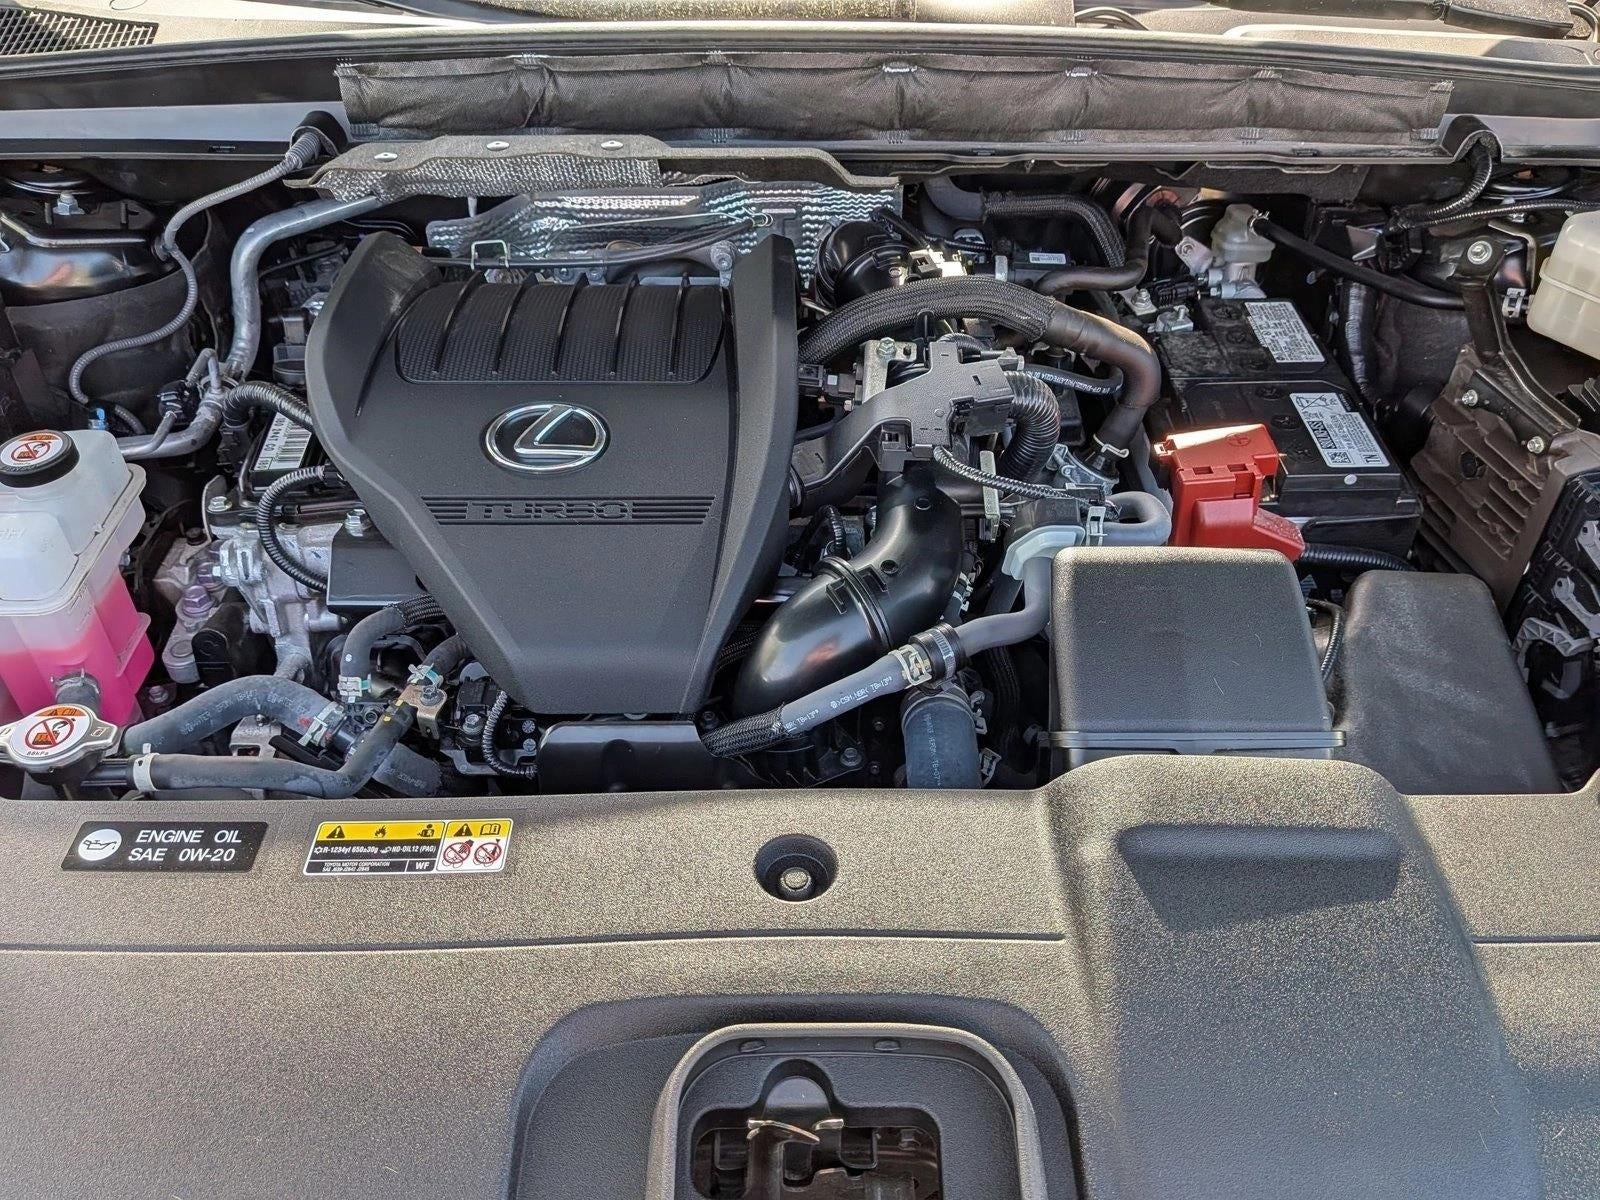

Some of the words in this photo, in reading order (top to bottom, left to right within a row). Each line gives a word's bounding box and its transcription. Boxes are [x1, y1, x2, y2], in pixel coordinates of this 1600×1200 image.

[472, 502, 628, 519] TURBO
[135, 829, 204, 843] ENGINE
[214, 829, 242, 843] OIL
[128, 847, 168, 861] SAE
[178, 848, 236, 862] 0W-20
[415, 861, 430, 870] WF
